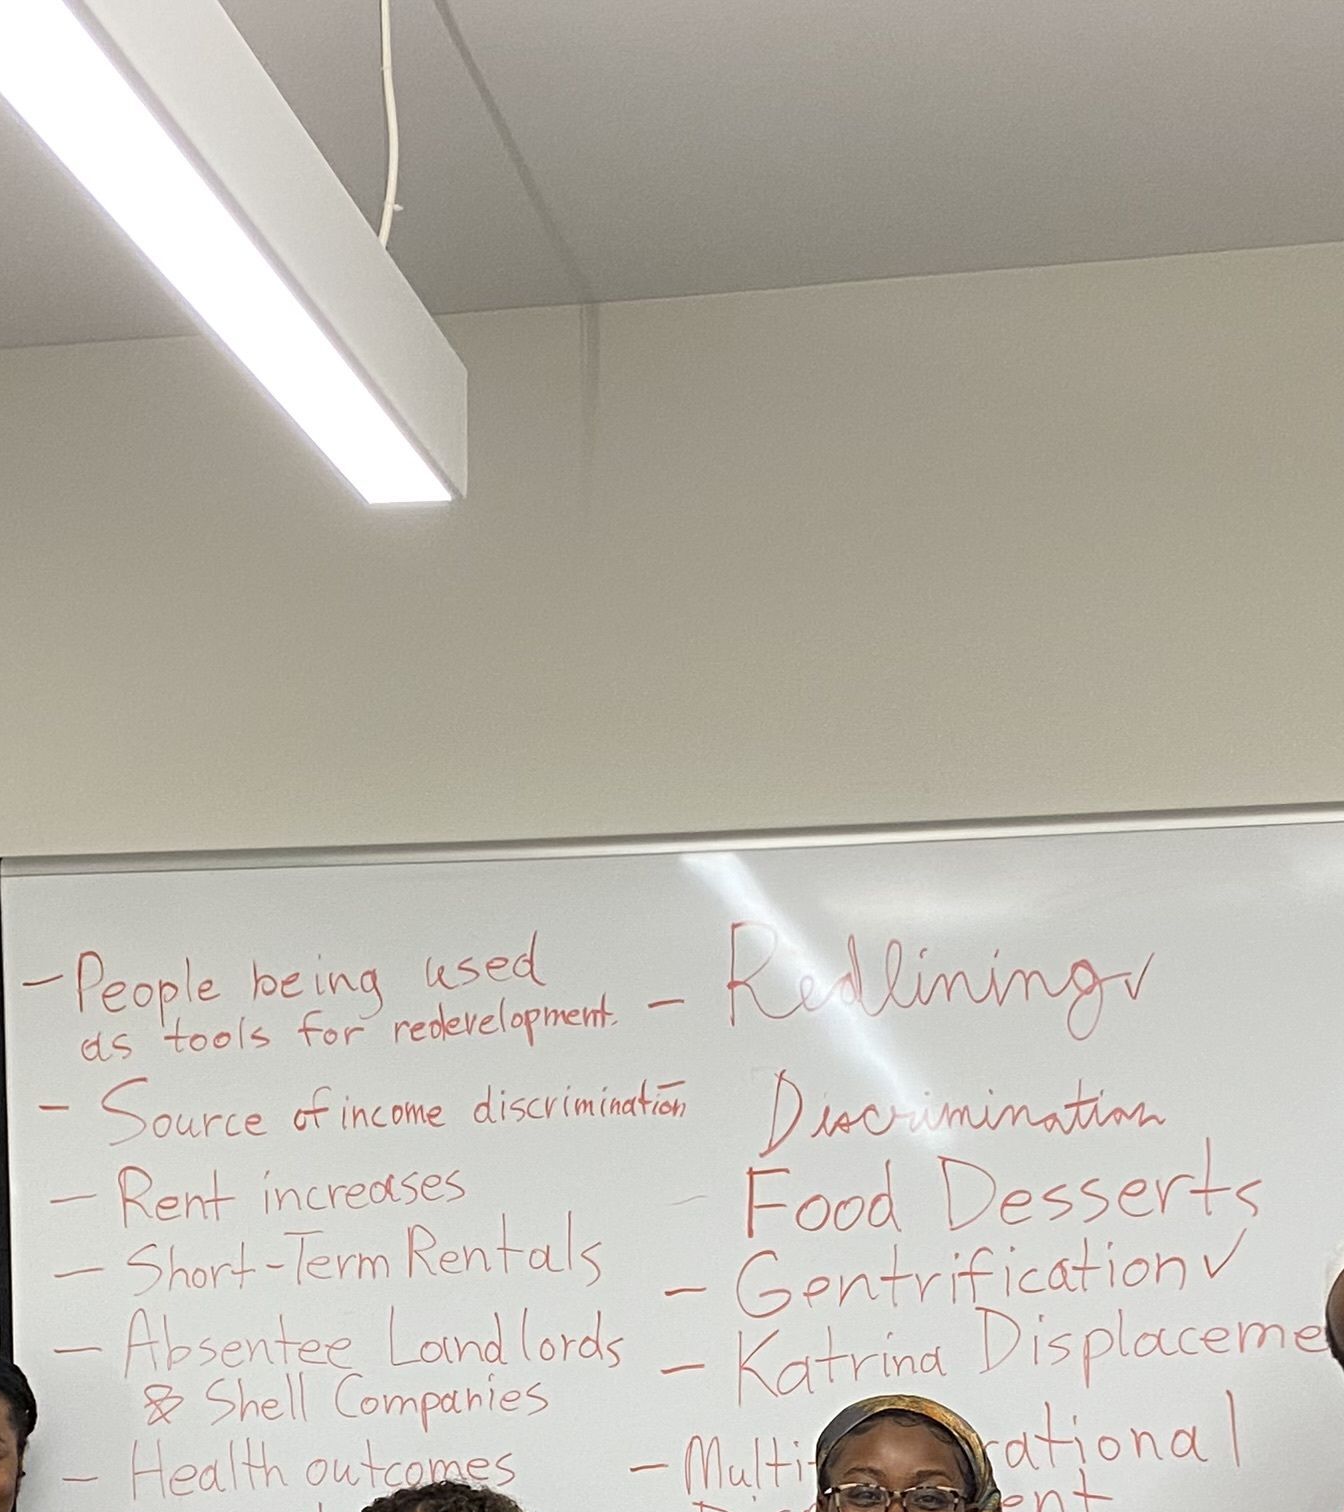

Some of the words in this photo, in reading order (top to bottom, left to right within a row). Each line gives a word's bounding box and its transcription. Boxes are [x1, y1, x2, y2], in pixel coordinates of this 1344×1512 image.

[77, 950, 221, 1028] People
[253, 954, 383, 1020] being
[426, 930, 546, 990] used
[726, 922, 1132, 1041] Redlining
[81, 1031, 132, 1062] as
[164, 1013, 272, 1053] tools
[297, 1010, 365, 1047] for
[101, 1077, 267, 1146] Source
[293, 1086, 331, 1131] of
[342, 1095, 446, 1130] income
[473, 1079, 686, 1124] discrimination
[758, 1069, 1166, 1158] Discrimination
[118, 1165, 236, 1228] Rent
[264, 1170, 465, 1214] increases
[746, 1159, 902, 1239] Food
[937, 1137, 1262, 1231] Desserts
[127, 1230, 389, 1296] Short-Term
[407, 1210, 602, 1287] Rentals
[736, 1237, 1186, 1322] Gentrification
[124, 1308, 352, 1378] Absentee
[390, 1305, 624, 1368] Landlords
[738, 1325, 947, 1407] Katrina
[975, 1306, 1328, 1389] Displaceme
[206, 1371, 307, 1426] Shell
[335, 1373, 549, 1433] Companies
[132, 1437, 288, 1500] Health
[306, 1439, 515, 1488] outcomes
